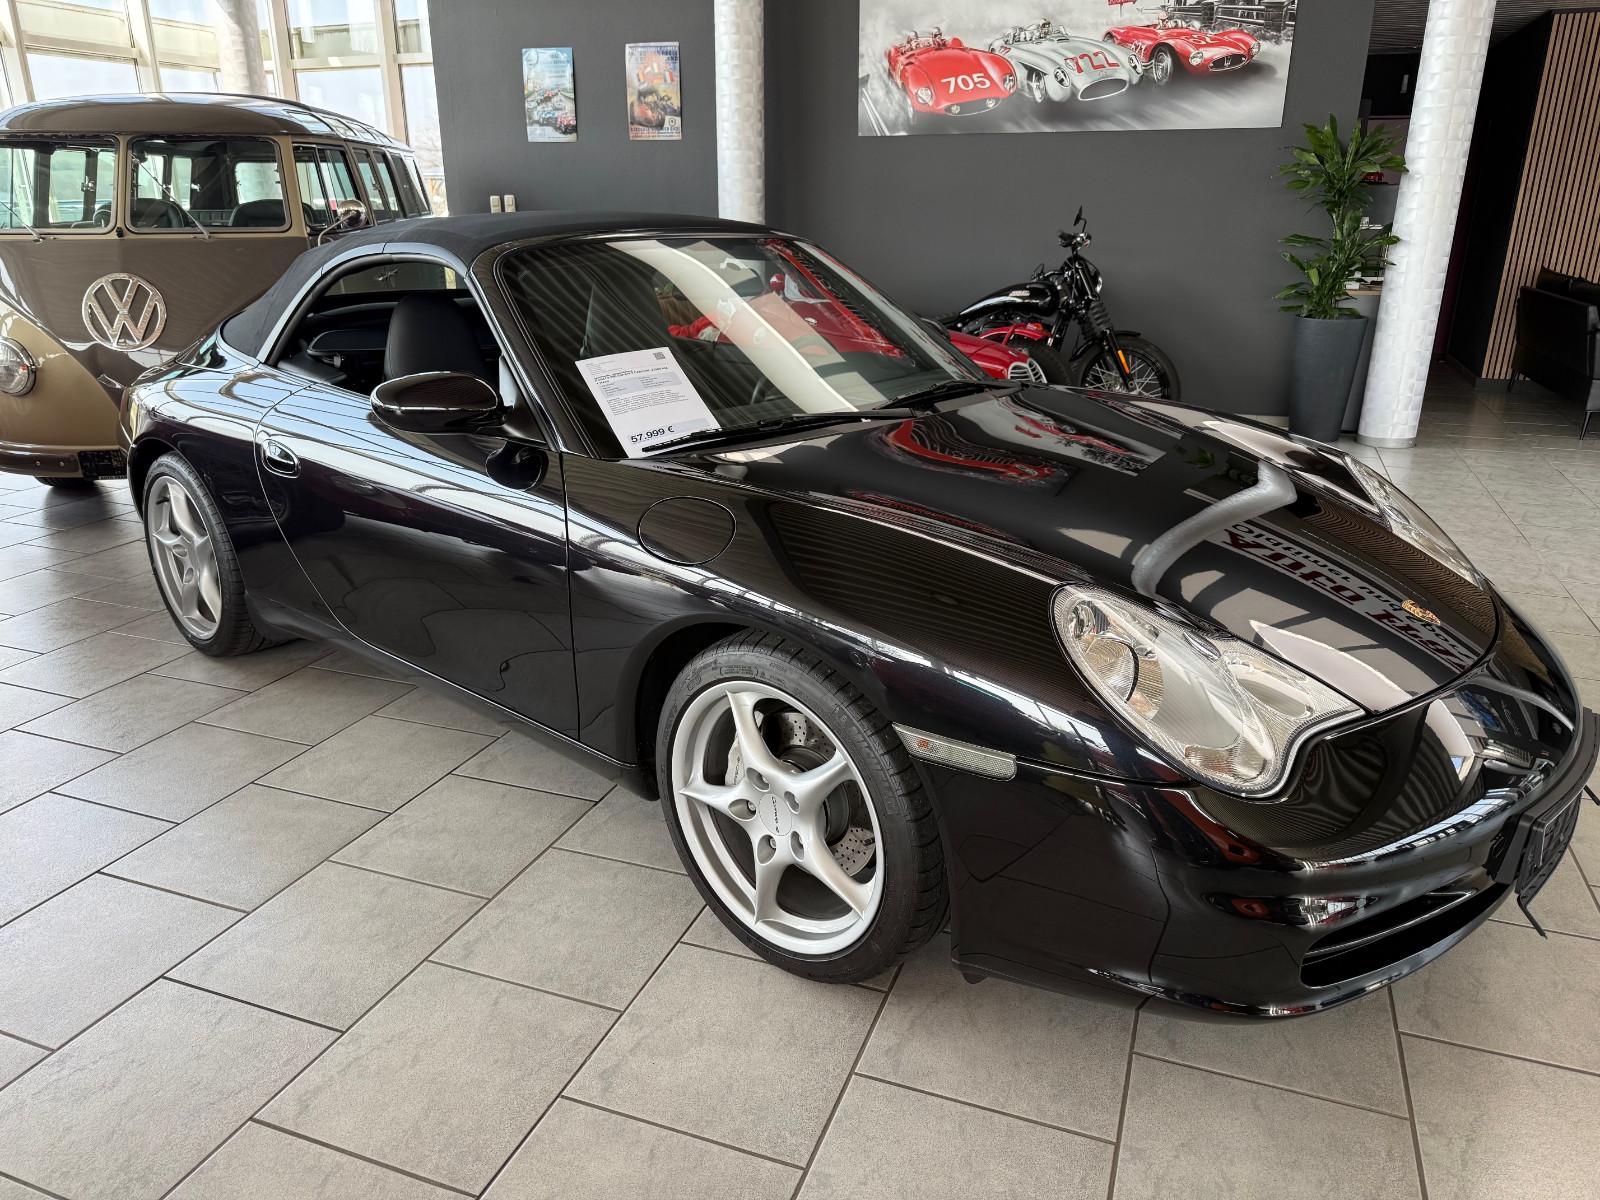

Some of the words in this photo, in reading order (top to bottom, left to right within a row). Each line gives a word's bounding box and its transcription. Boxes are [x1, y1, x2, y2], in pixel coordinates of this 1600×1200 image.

[1063, 50, 1121, 73] 722
[940, 73, 991, 94] 705
[630, 428, 665, 443] 57.999
